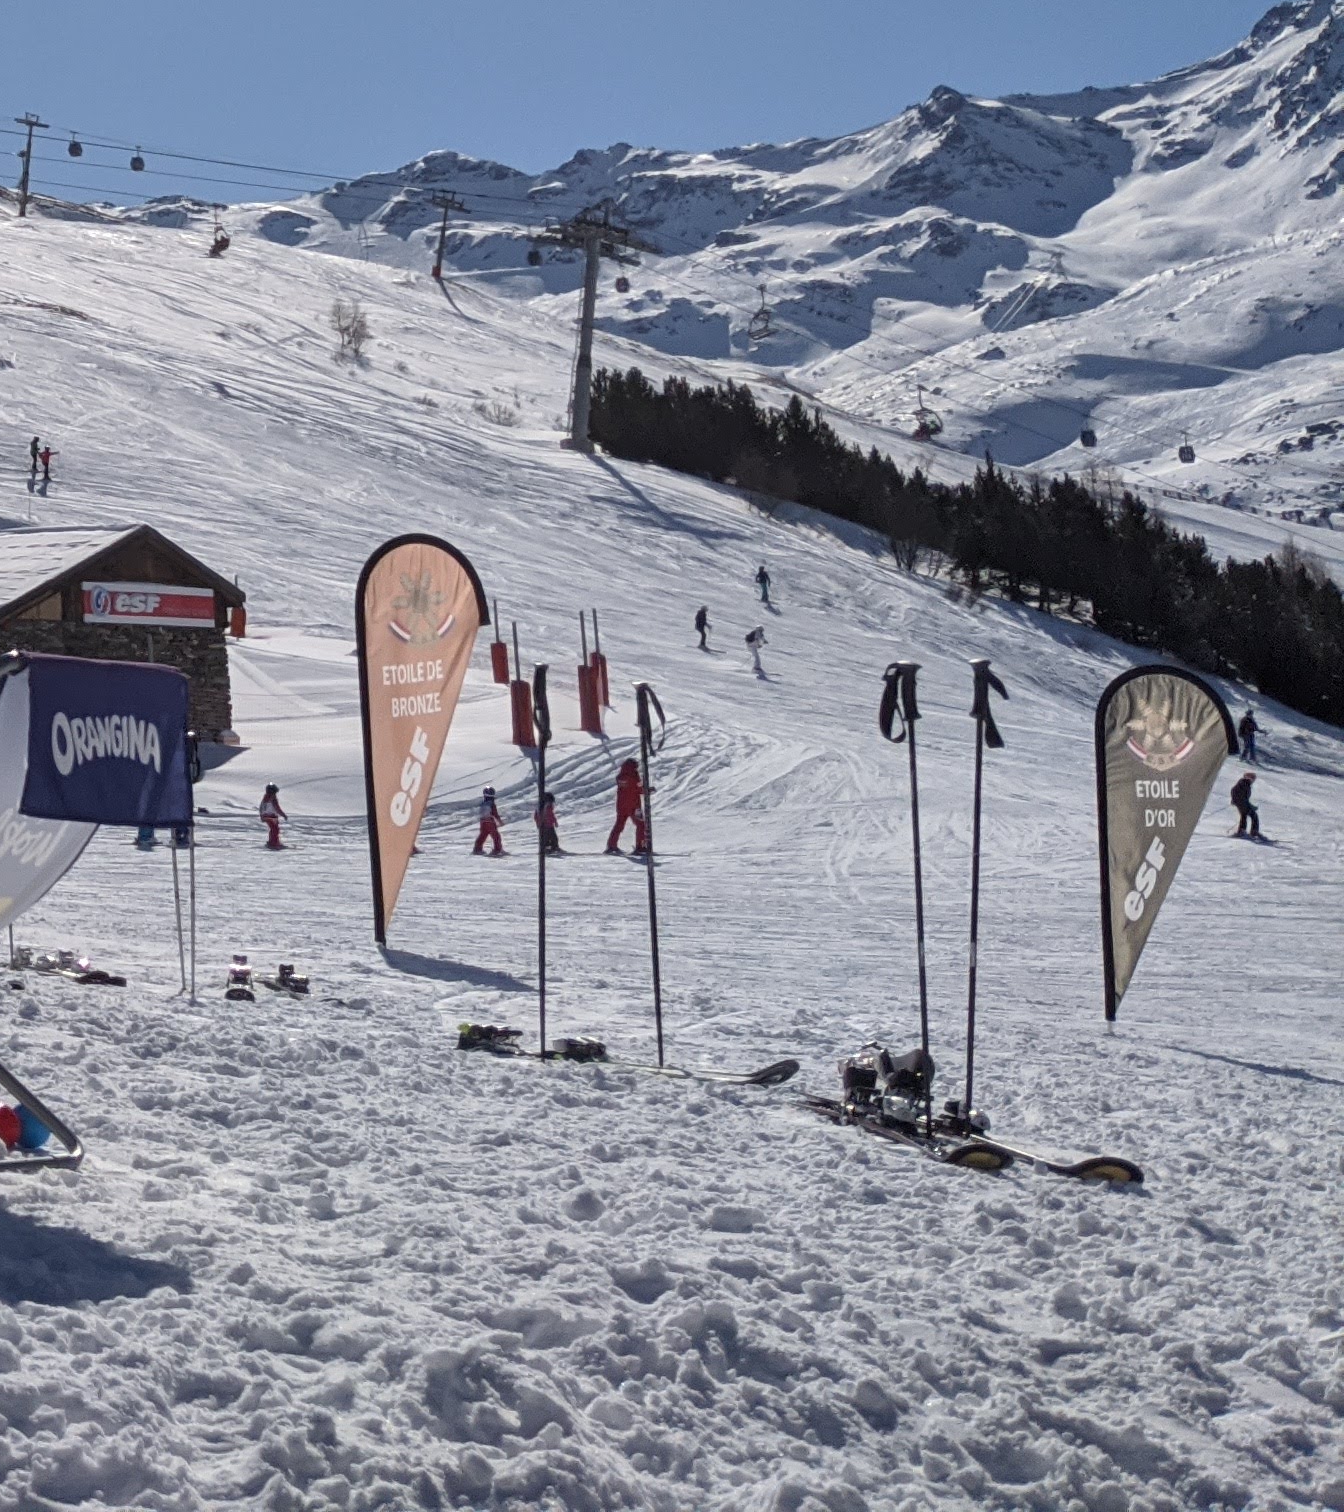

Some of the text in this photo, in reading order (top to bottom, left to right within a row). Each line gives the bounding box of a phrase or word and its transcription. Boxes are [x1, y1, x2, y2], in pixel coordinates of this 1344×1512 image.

[382, 659, 444, 686] ETOILE DE
[392, 692, 441, 718] BRONZE
[51, 711, 161, 776] ORANGINA
[1135, 780, 1180, 799] ETOILE
[1145, 809, 1176, 828] D'OR
